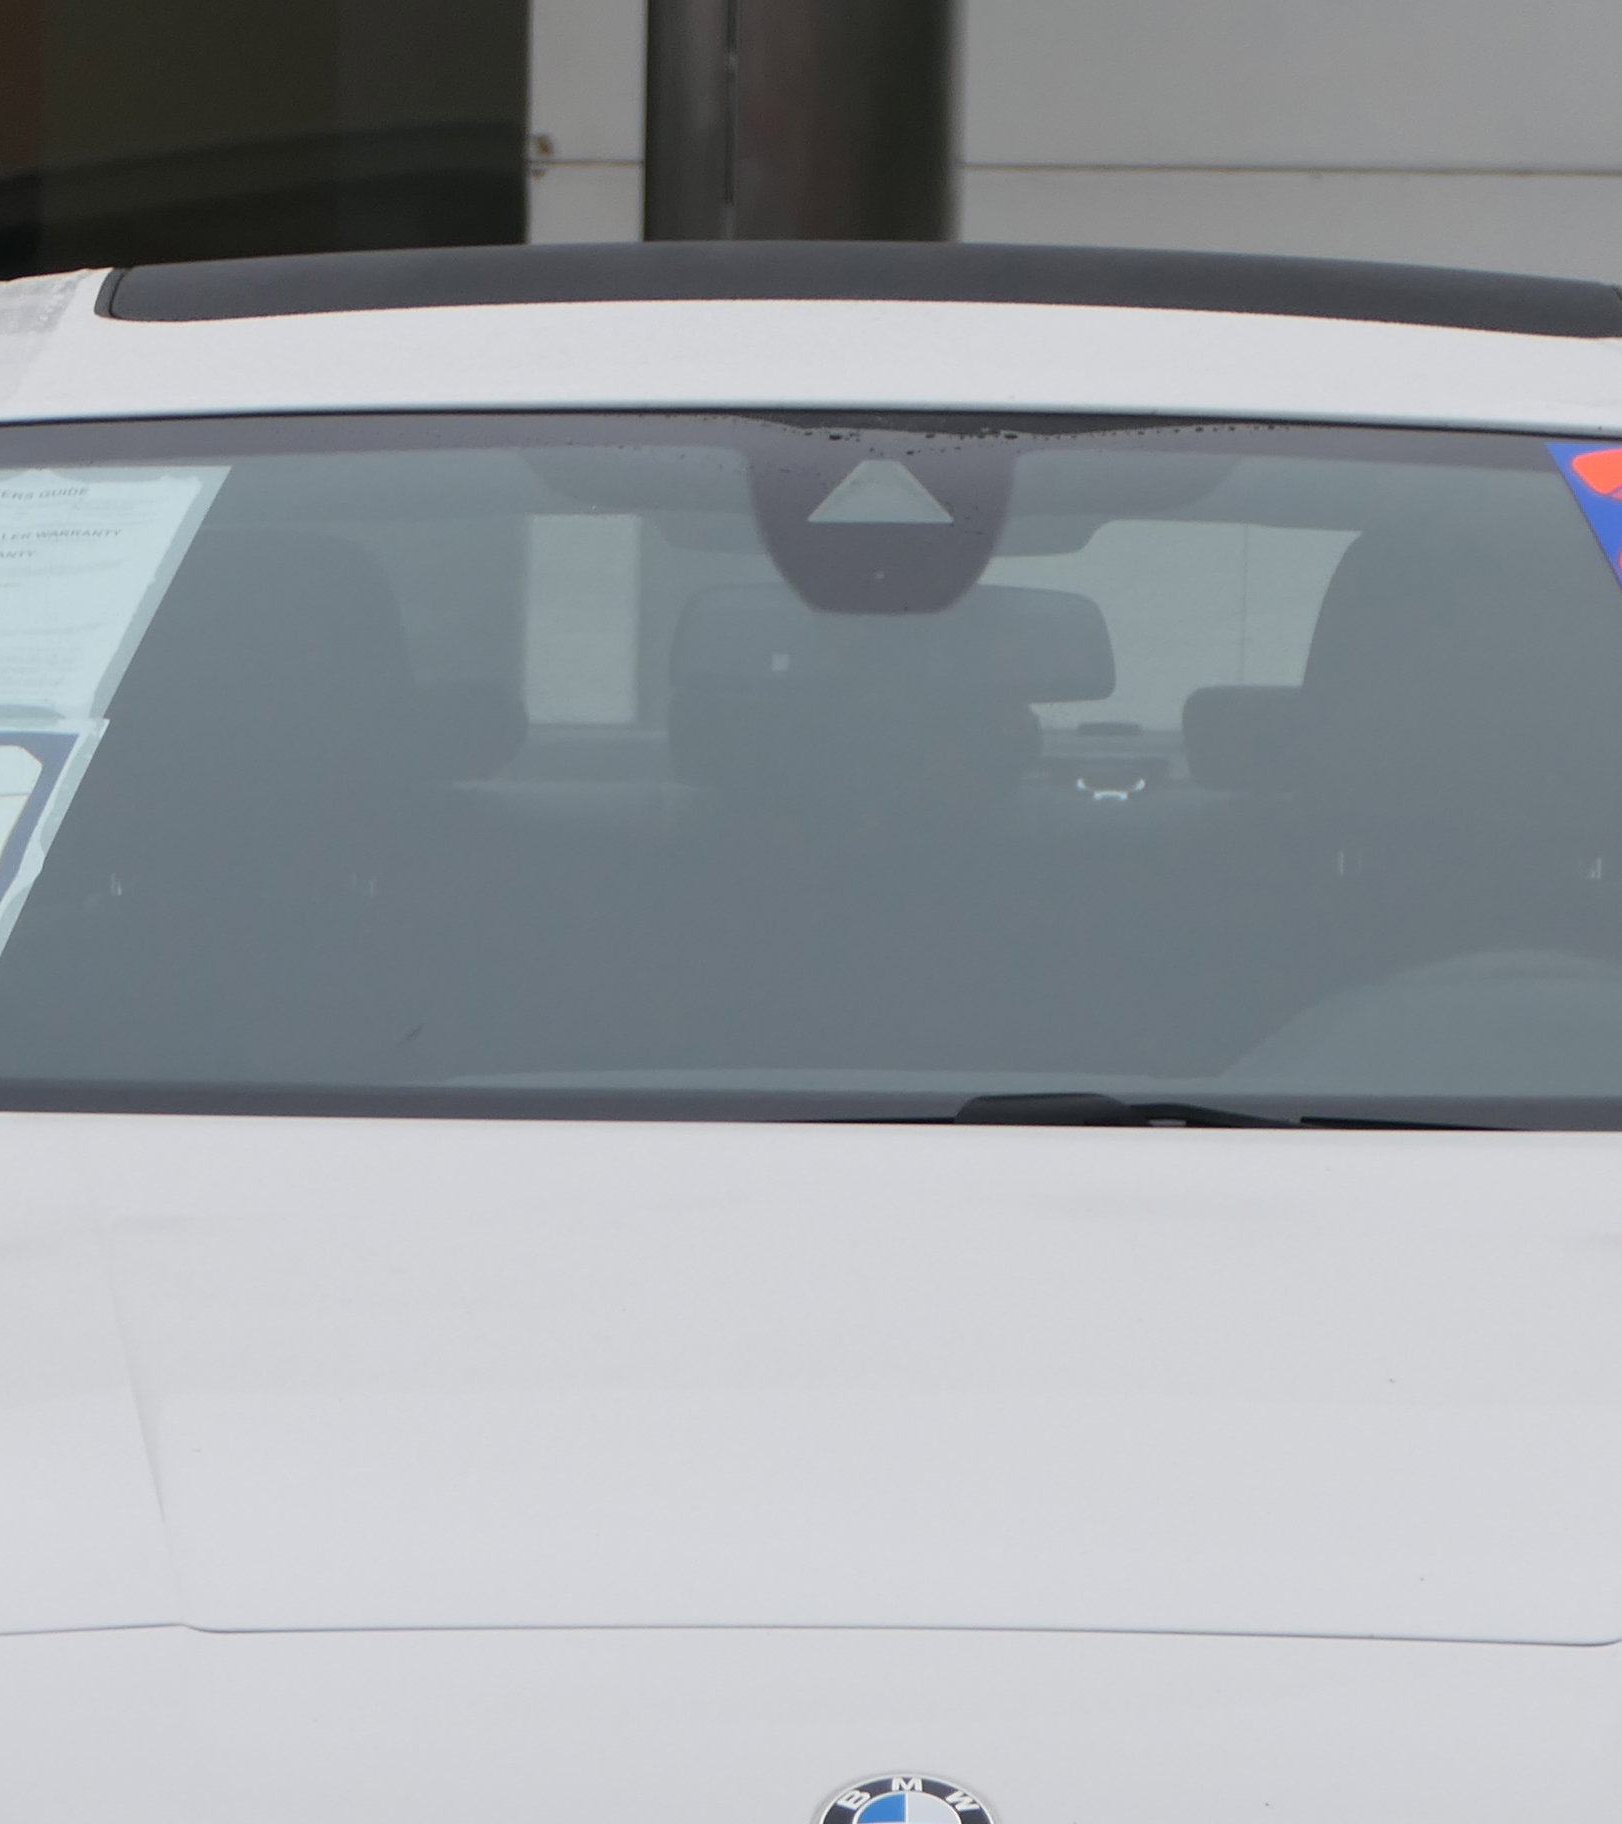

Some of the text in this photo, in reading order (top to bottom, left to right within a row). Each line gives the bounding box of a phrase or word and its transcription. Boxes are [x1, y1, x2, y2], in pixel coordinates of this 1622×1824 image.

[38, 486, 90, 499] GUIDE
[35, 527, 123, 540] WARRANTY
[836, 1776, 980, 1812] BMW
